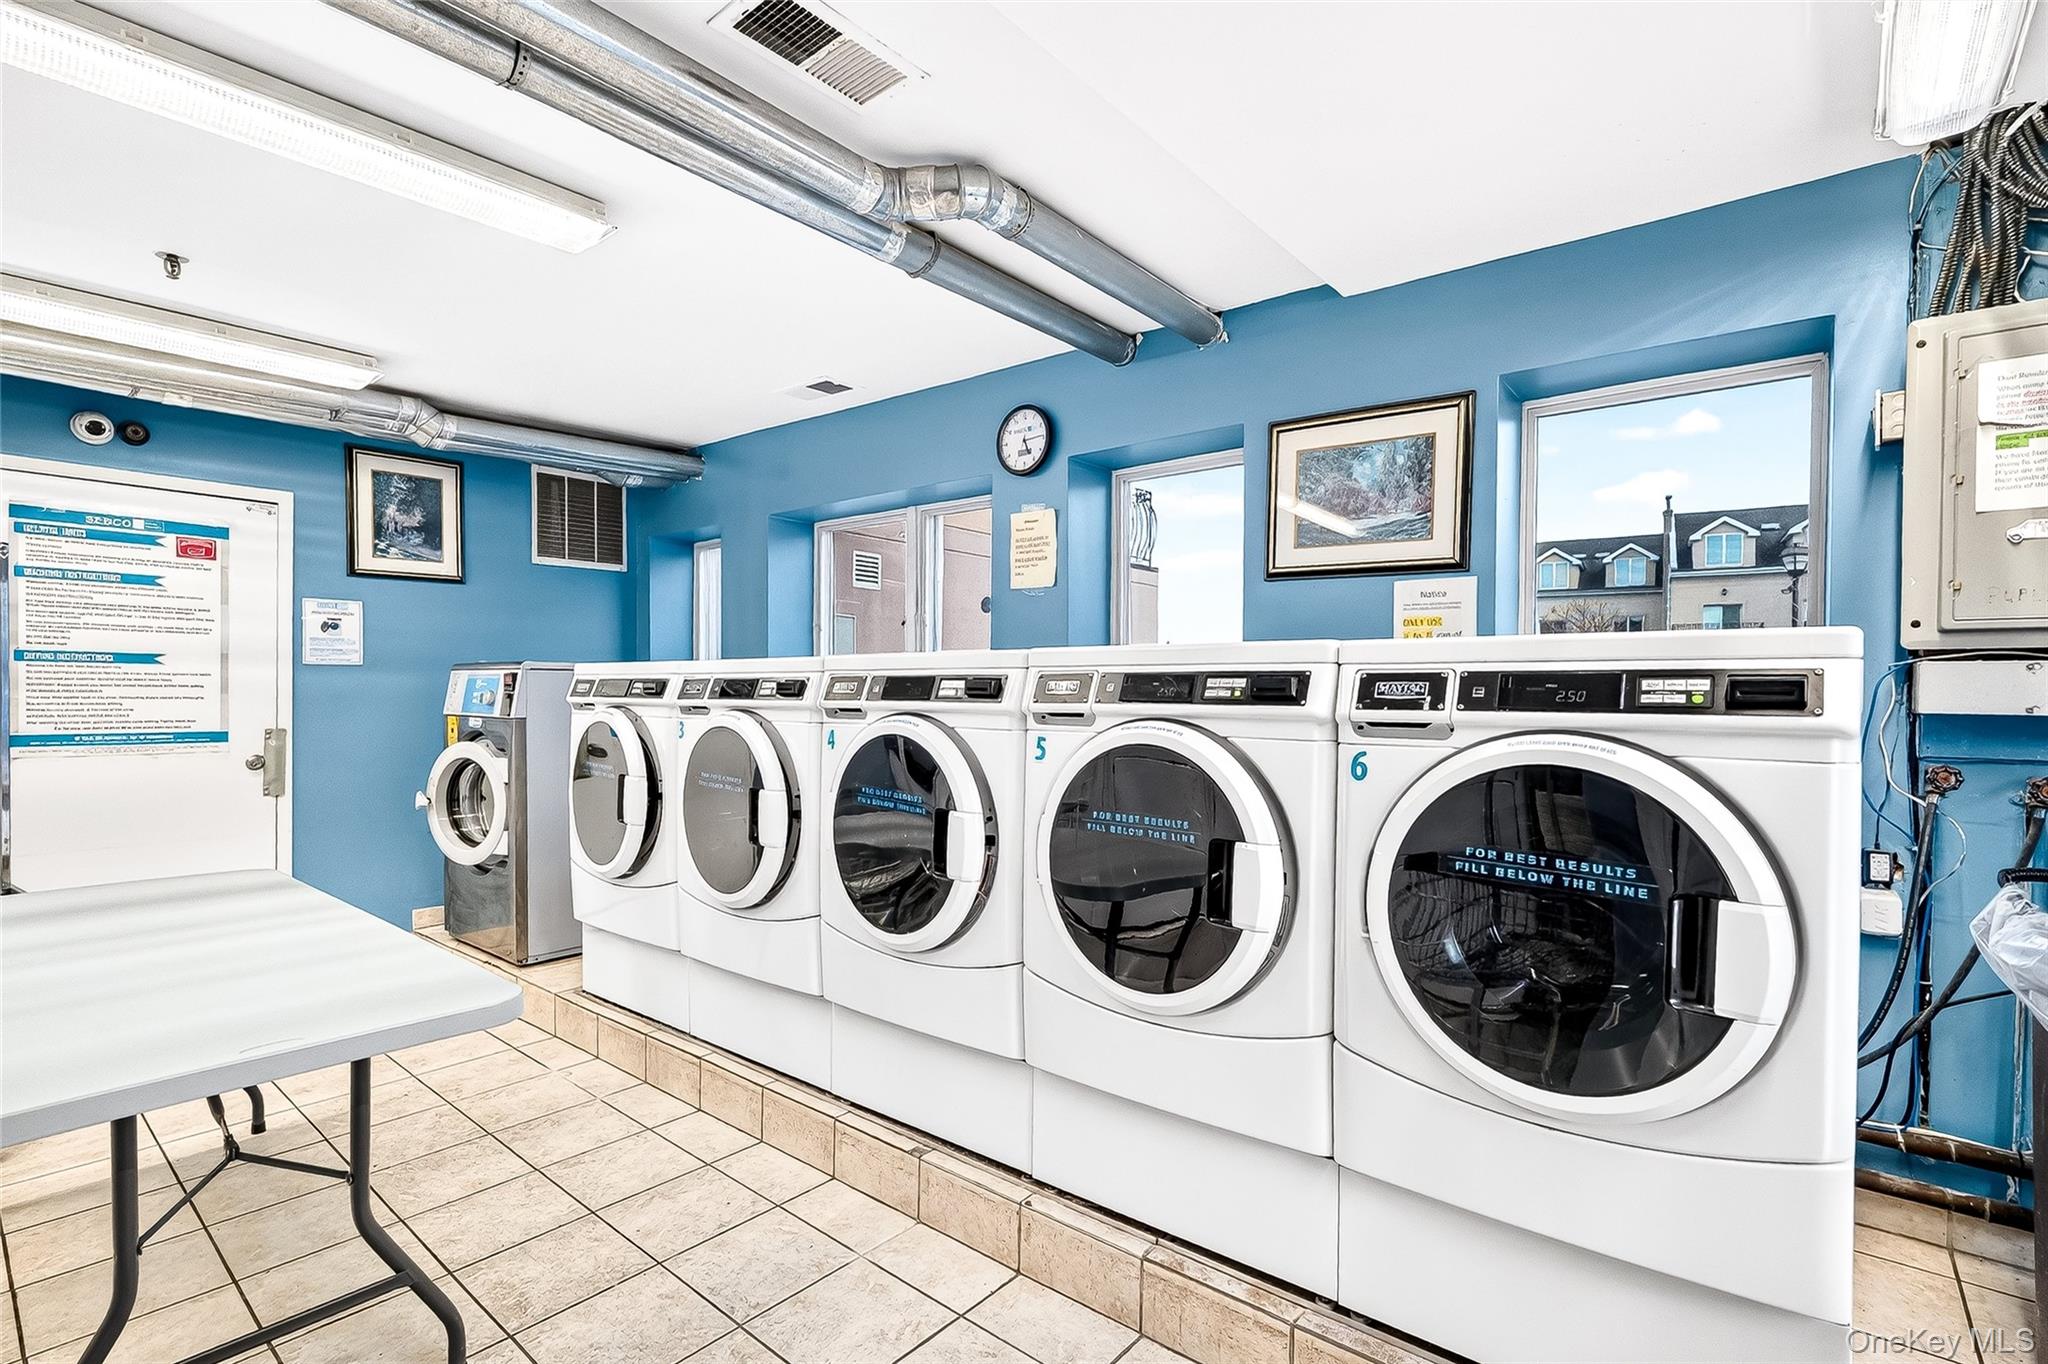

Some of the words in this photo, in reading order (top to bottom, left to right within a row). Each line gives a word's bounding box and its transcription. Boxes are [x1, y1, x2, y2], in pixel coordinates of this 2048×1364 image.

[678, 720, 686, 739] 3
[826, 729, 836, 750] 4
[1035, 736, 1047, 761] 5
[1350, 751, 1368, 781] 6
[1465, 846, 1498, 860] FOR
[1504, 852, 1547, 867] BEST
[1555, 858, 1637, 879] RESULTS
[1455, 861, 1489, 875] FILL
[1495, 867, 1555, 885] BELOW
[1562, 876, 1596, 891] THE
[1604, 883, 1649, 899] LINE
